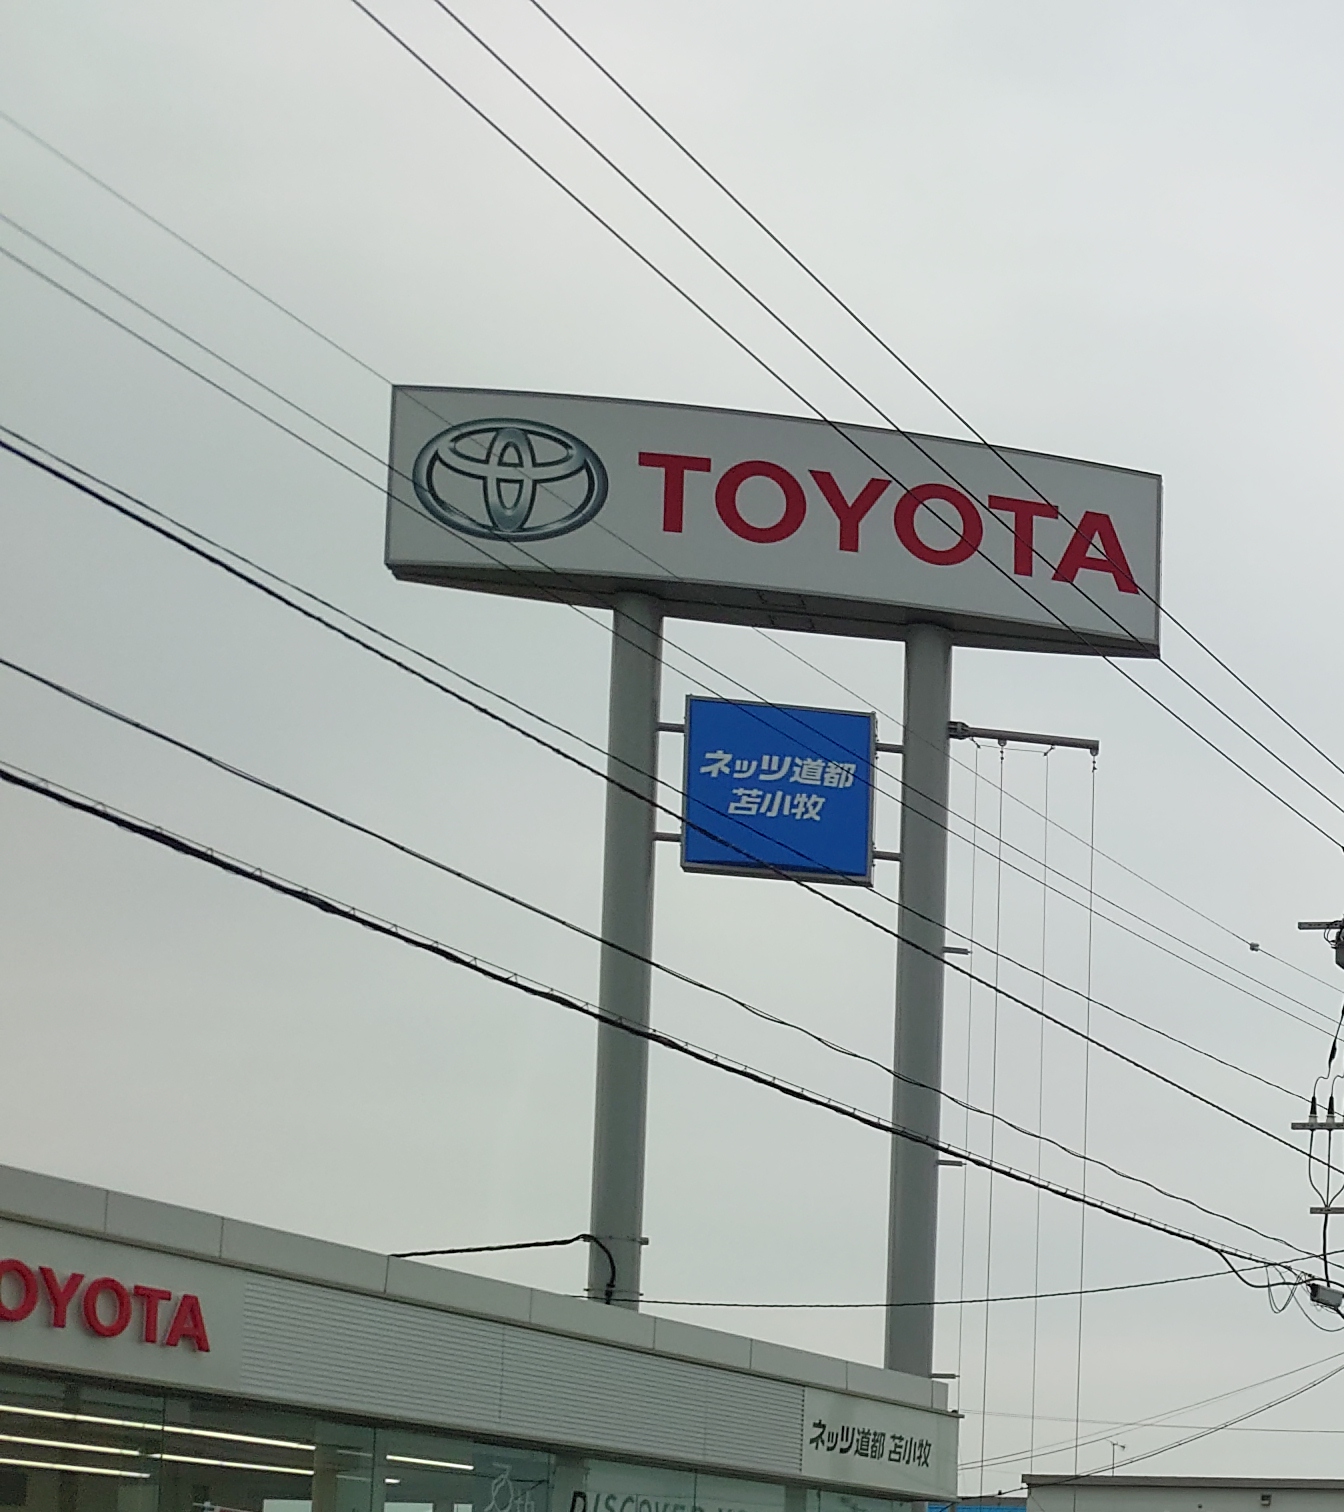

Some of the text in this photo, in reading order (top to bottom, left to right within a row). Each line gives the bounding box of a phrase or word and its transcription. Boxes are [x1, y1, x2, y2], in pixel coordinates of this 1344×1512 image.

[638, 451, 1140, 595] TOYOTA
[700, 750, 856, 789] ネッツ道都
[727, 787, 826, 821] 苫小牧
[809, 1419, 932, 1468] ネッツ道都 苫小牧
